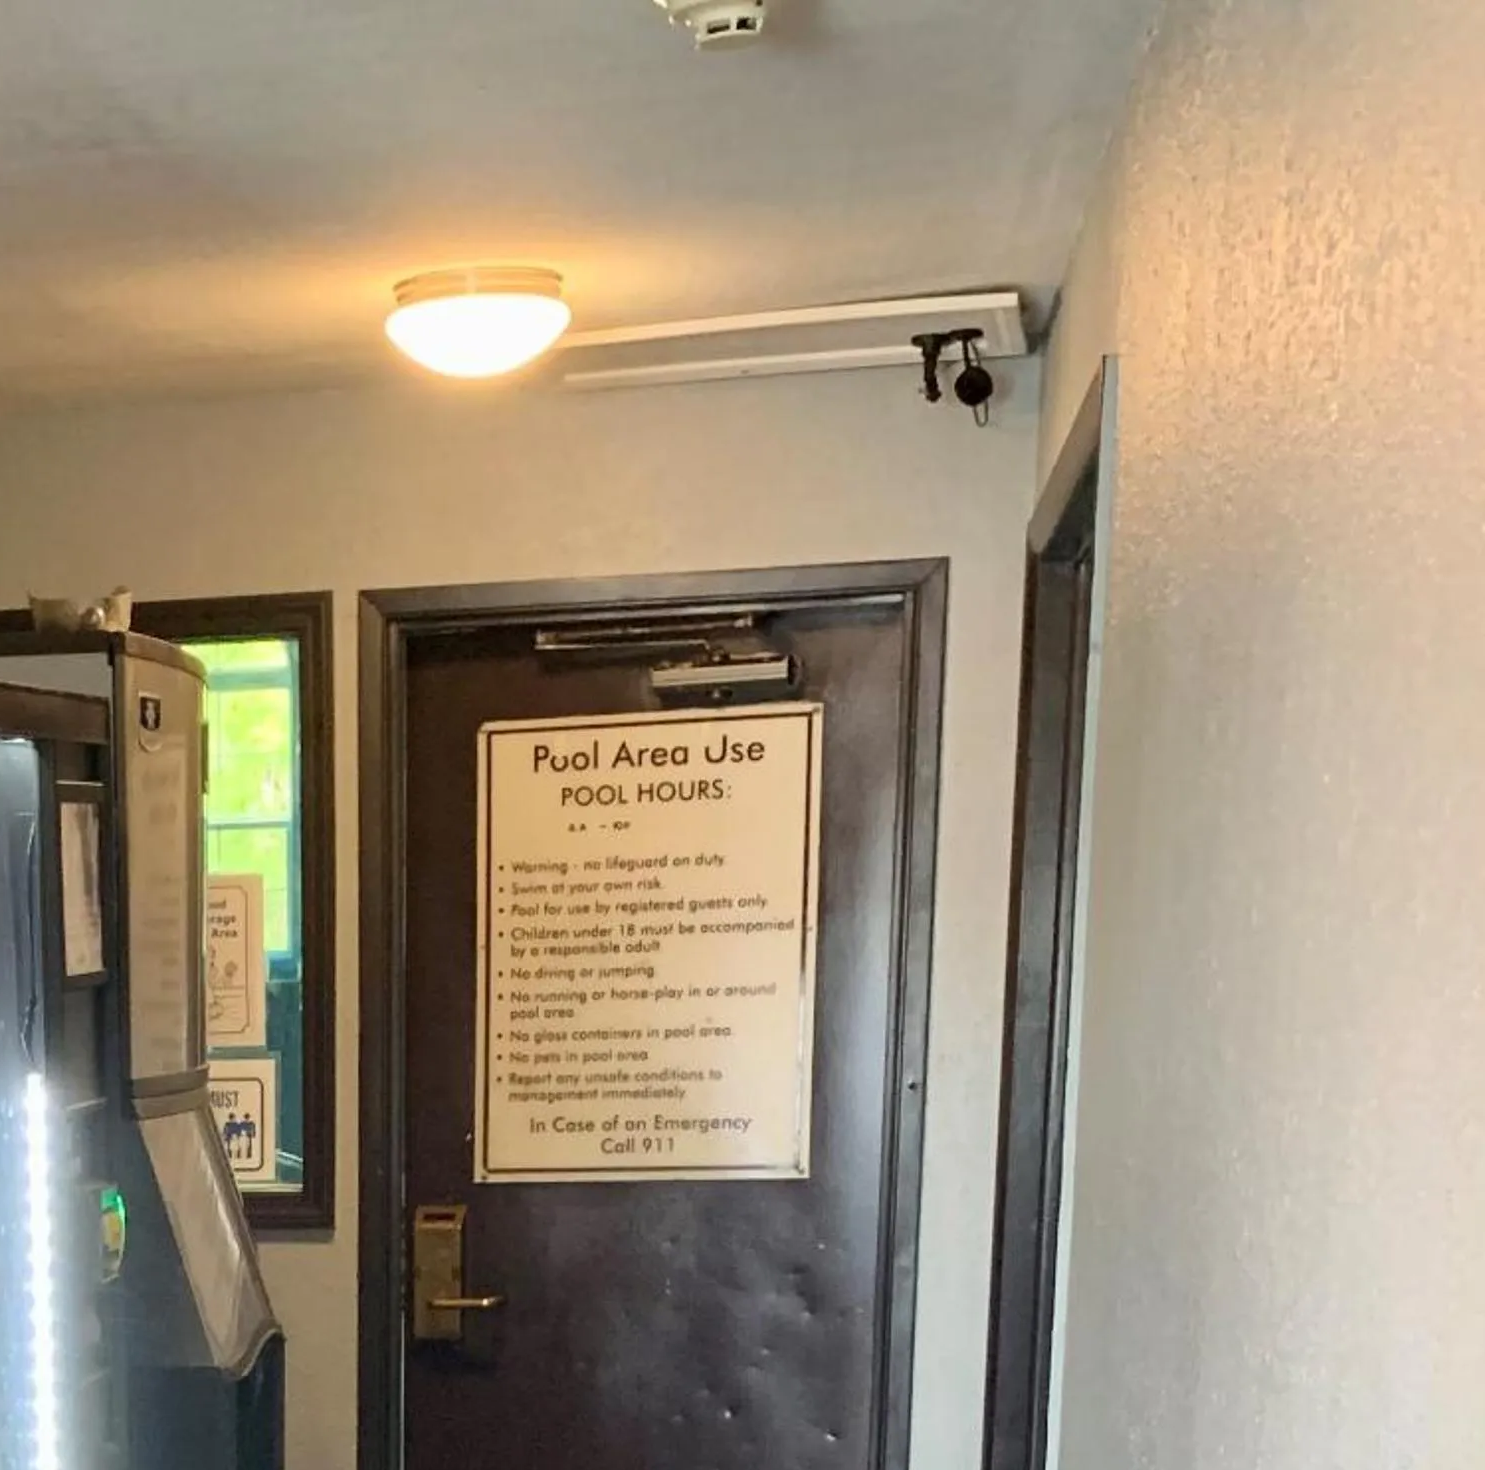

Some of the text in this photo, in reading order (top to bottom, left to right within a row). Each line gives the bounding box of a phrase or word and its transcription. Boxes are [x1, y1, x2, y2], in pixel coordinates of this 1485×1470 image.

[533, 733, 765, 773] Pool Area Use
[561, 778, 732, 807] POOL HOURS:
[511, 860, 568, 875] Warning
[583, 861, 601, 871] no
[605, 855, 667, 872] lifeguard
[672, 857, 690, 867] on
[511, 882, 548, 896] Swim
[551, 882, 565, 894] at
[567, 882, 600, 896] your
[603, 882, 633, 892] own
[510, 903, 539, 917] Pool
[543, 902, 562, 915] for
[567, 904, 590, 914] use
[595, 899, 611, 916] by
[615, 897, 684, 915] registered
[689, 898, 733, 913] guests
[211, 928, 238, 938] Area
[510, 926, 570, 941] Children
[573, 924, 612, 938] under
[640, 923, 674, 935] must
[678, 921, 696, 934] be
[700, 919, 795, 934] accompanied
[510, 939, 660, 959] by a responsible adult
[510, 965, 654, 981] No diving or jumping
[510, 982, 776, 1005] No running or horse-play in or around
[509, 1005, 575, 1021] pool area
[509, 1023, 732, 1045] No glass containers in pool area
[509, 1048, 649, 1065] No pets in pool area
[508, 1067, 723, 1087] Report any unsafe conditions to
[507, 1085, 687, 1105] management immediately
[529, 1113, 753, 1134] In Case of an Emergency
[600, 1137, 676, 1155] Call 911
